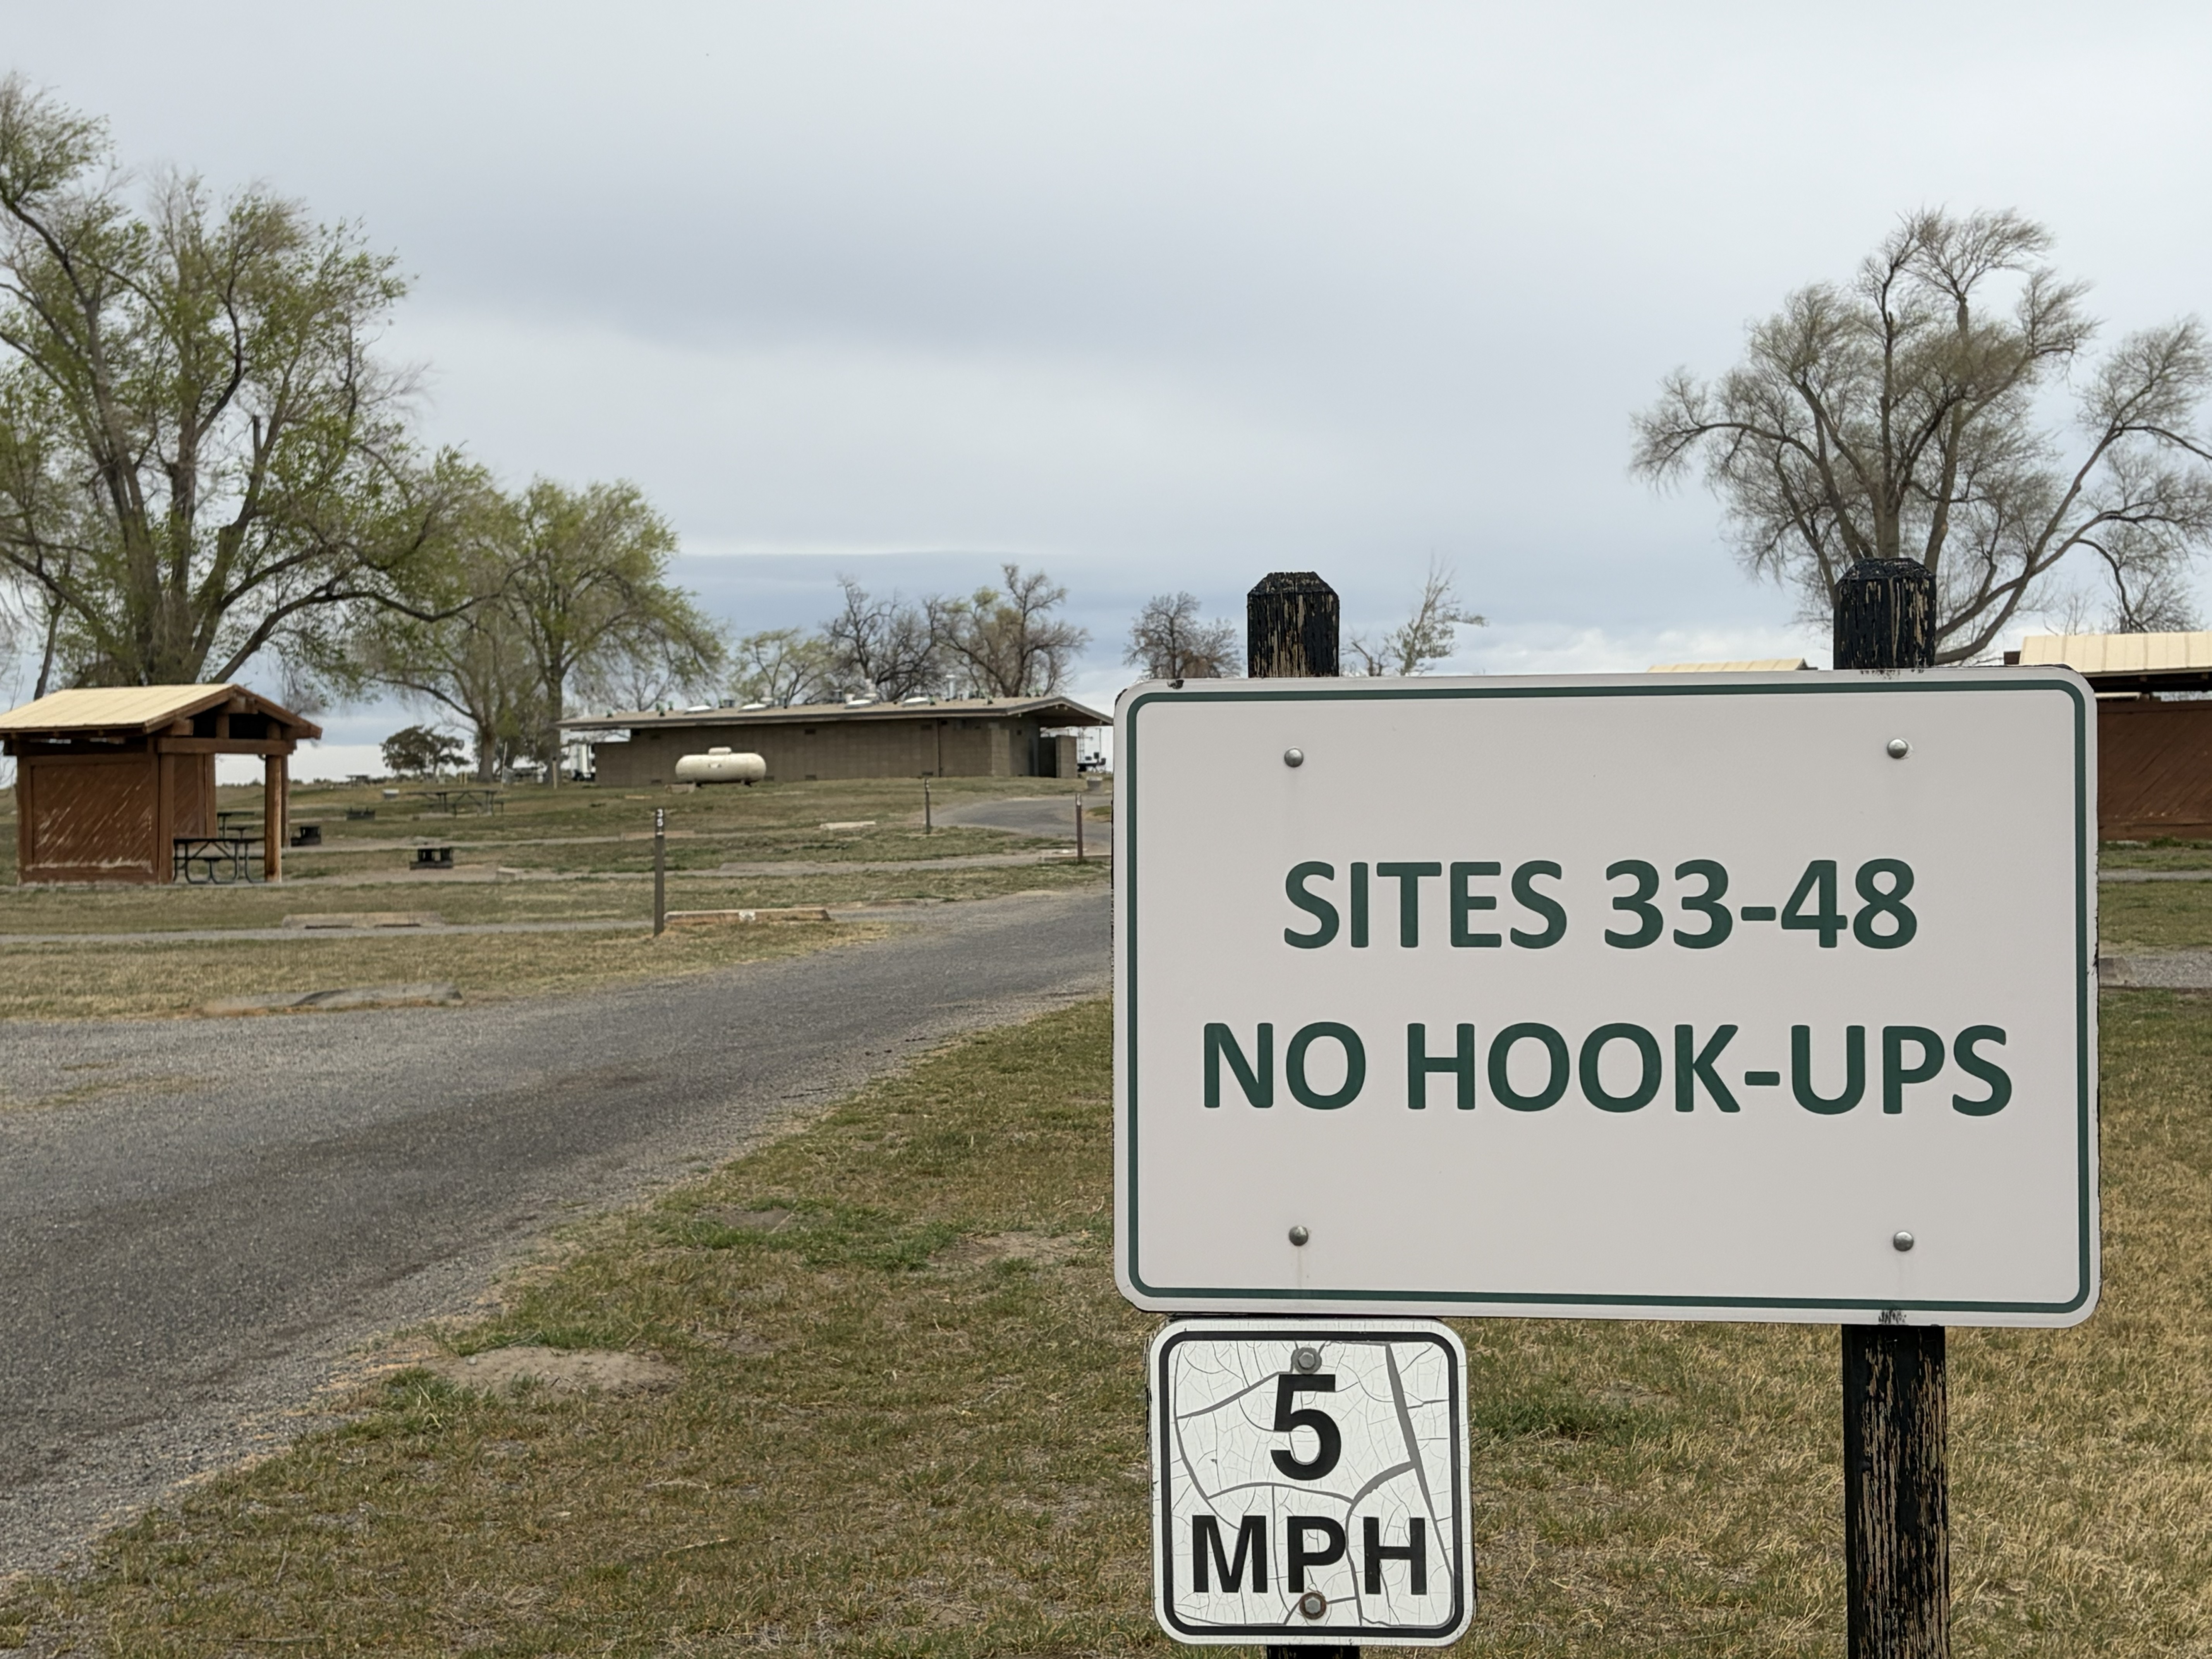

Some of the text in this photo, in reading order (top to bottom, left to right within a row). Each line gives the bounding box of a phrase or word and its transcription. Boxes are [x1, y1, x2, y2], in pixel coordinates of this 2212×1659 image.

[1283, 858, 1918, 950] SITES 33-48
[1203, 1022, 2013, 1117] NO HOOK-UPS
[1270, 1374, 1342, 1481] 5
[1192, 1515, 1428, 1595] MPH
